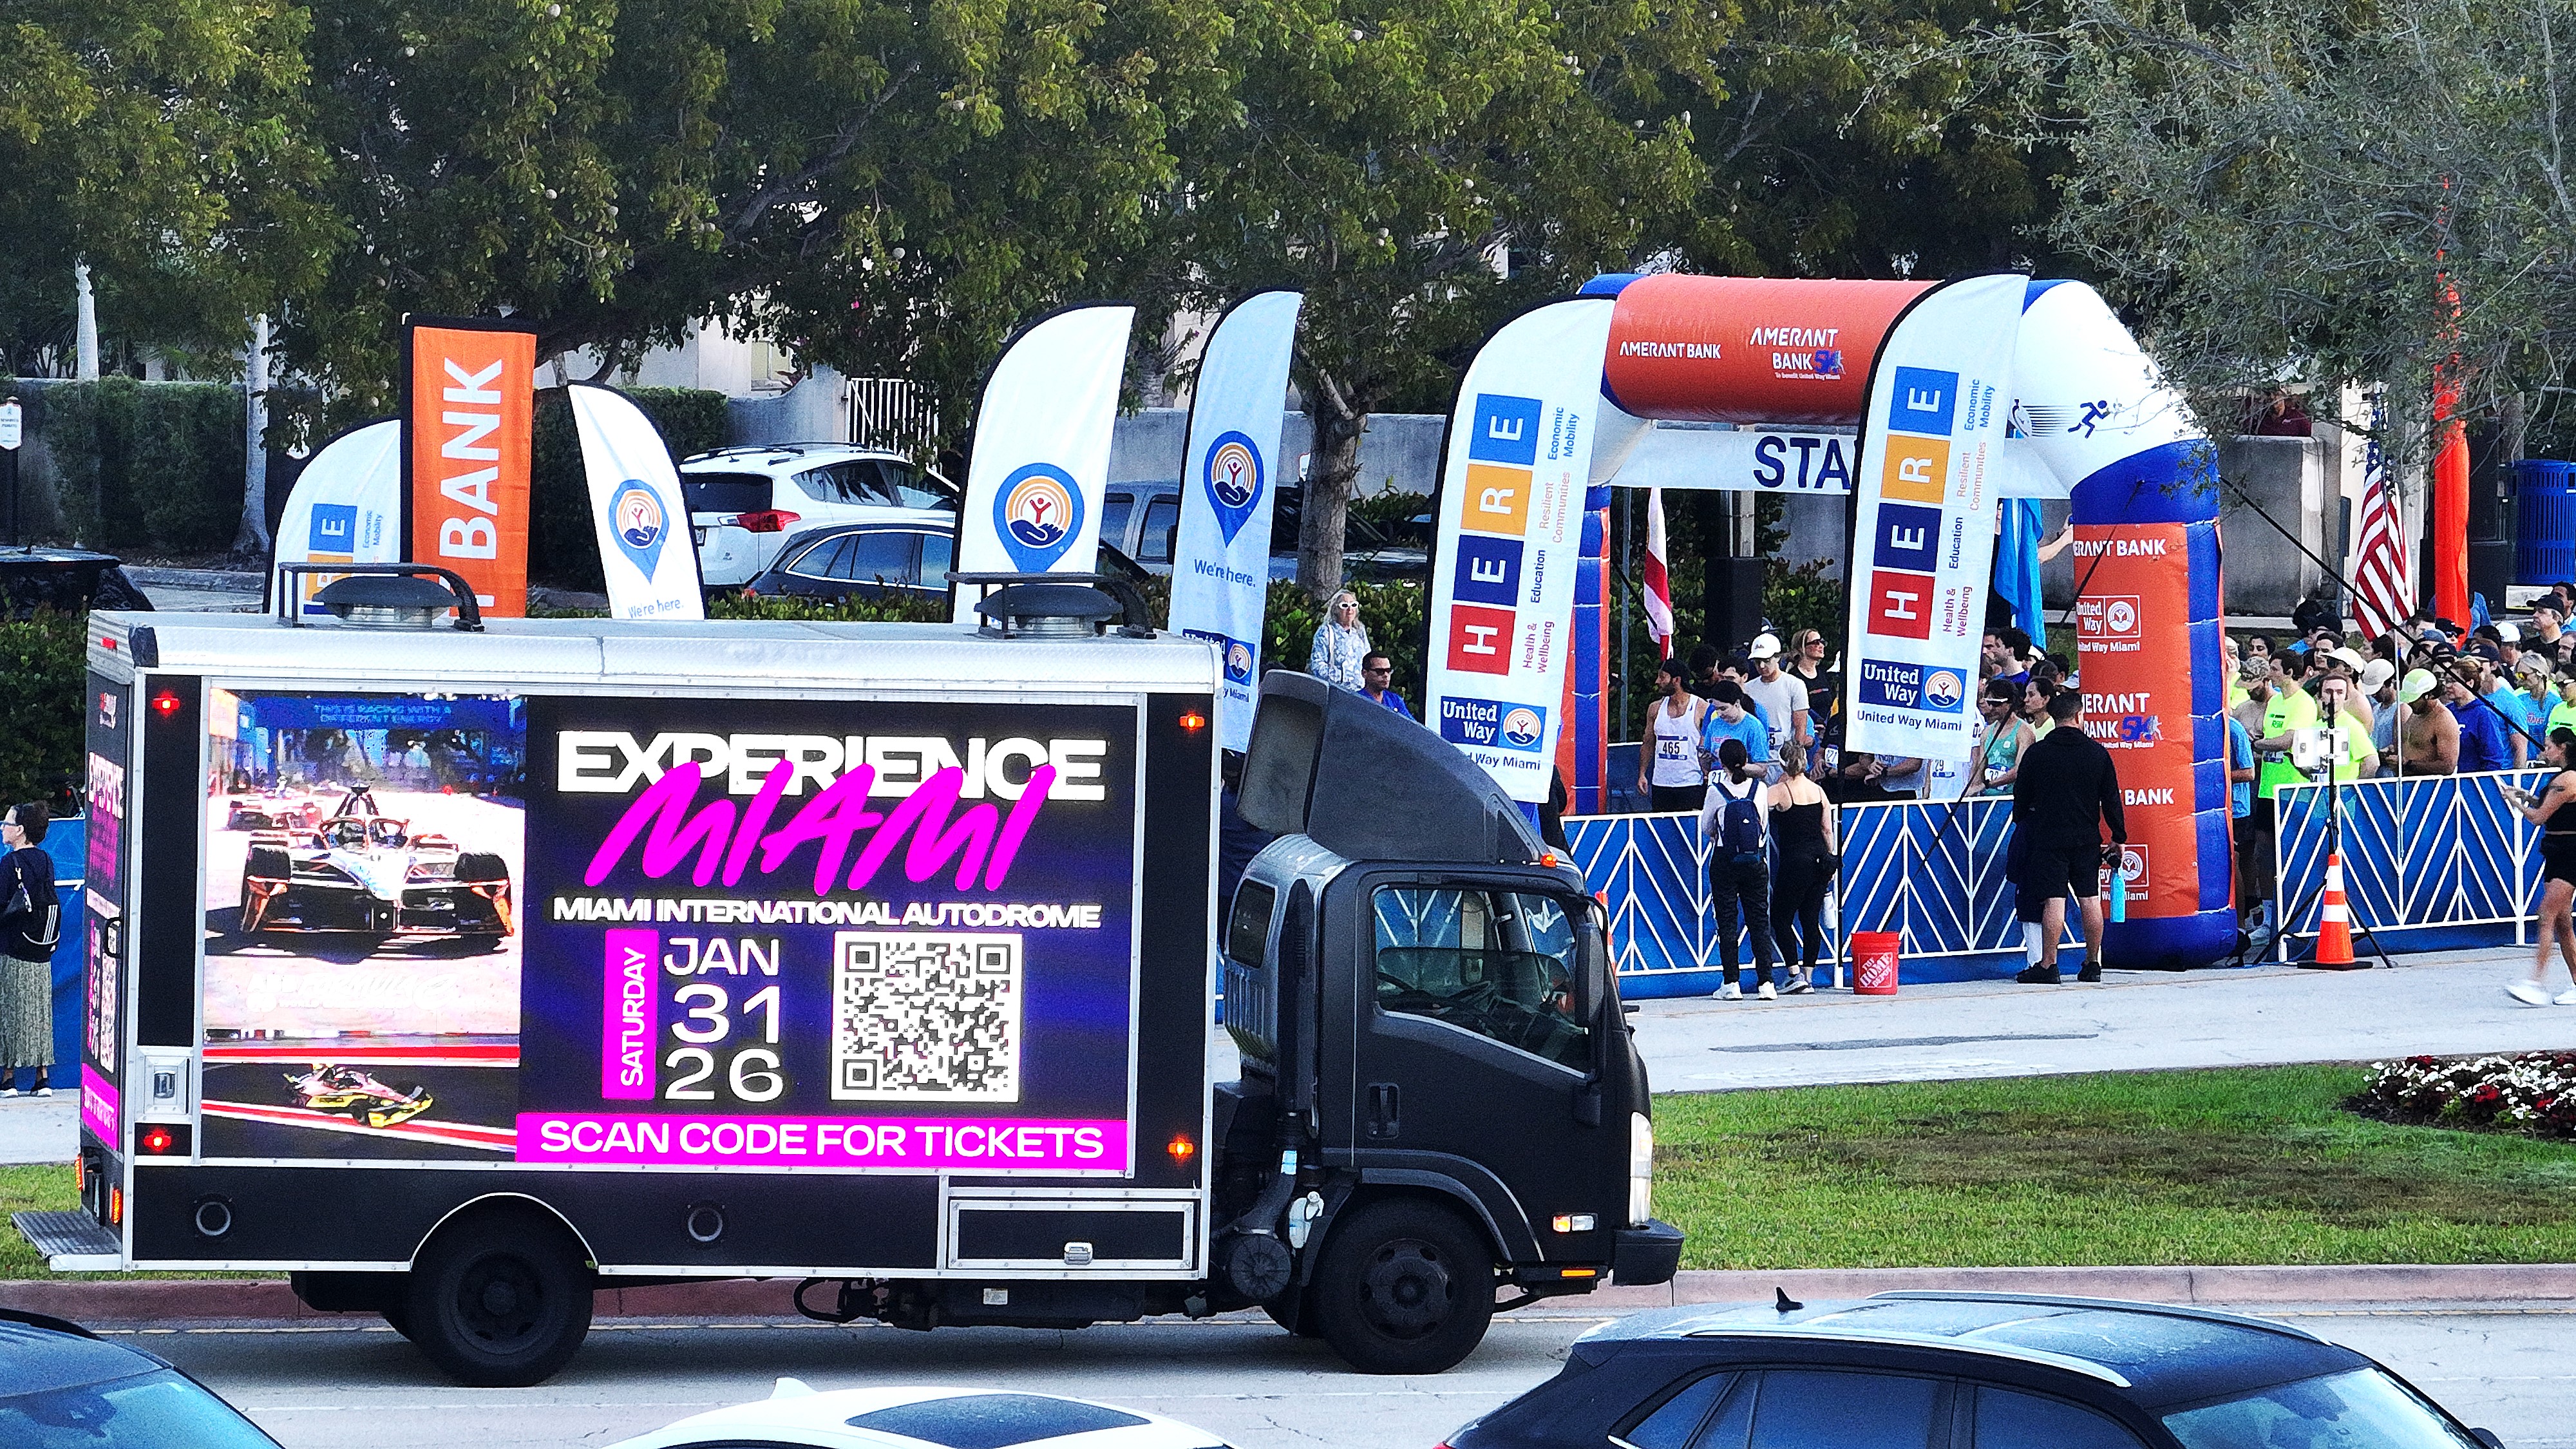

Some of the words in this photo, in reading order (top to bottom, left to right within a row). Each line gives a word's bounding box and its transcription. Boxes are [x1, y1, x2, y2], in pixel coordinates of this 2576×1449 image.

[1620, 341, 1685, 357] AMERANT
[1687, 343, 1721, 359] BANK
[1750, 327, 1839, 347] AMERANT
[1772, 352, 1813, 370] BANK
[1964, 379, 1980, 431] Economic
[1980, 385, 1995, 428] Mobility
[1548, 406, 1564, 460] Economic
[1563, 413, 1580, 457] Mobility
[439, 357, 502, 559] BANK
[1754, 435, 1852, 490] STA
[1957, 451, 1971, 498] Resilient
[1969, 442, 1986, 511] Communities
[1539, 482, 1554, 529] Resilient
[1552, 471, 1571, 544] Communities
[363, 509, 373, 548] Economic
[1949, 516, 1964, 569] Education
[2072, 540, 2114, 556] ERANT
[2116, 538, 2167, 556] BANK
[1194, 558, 1224, 579] We're
[1226, 567, 1256, 587] here.
[1530, 549, 1546, 603] Education
[656, 599, 684, 612] here.
[1942, 598, 1955, 632] Health
[1956, 586, 1973, 637] Wellbeing
[1528, 623, 1537, 631] &
[2083, 617, 2103, 634] Way
[1522, 633, 1536, 668] Health
[1537, 621, 1555, 673] Wellbeing
[2110, 641, 2140, 652] Miami
[1864, 663, 1919, 685] United
[1230, 687, 1249, 703] Miami
[1443, 701, 1497, 723] United
[1884, 683, 1918, 706] Way
[2081, 692, 2151, 714] ERANT
[1463, 721, 1496, 744] Way
[1857, 710, 1895, 724] United
[1898, 714, 1922, 730] Way
[1925, 717, 1962, 732] Miami
[557, 730, 1106, 802] EXPERIENCE
[1475, 752, 1499, 768] Way
[1503, 756, 1541, 770] Miami
[1663, 742, 1680, 755] 465
[2125, 788, 2174, 806] BANK
[584, 759, 1057, 896] MIAMI
[2099, 868, 2112, 883] ay
[554, 897, 652, 922] MIAMI
[656, 898, 900, 926] INTERNATIONAL
[902, 902, 1103, 929] AUTODROME
[663, 937, 779, 977] JAN
[620, 947, 647, 1088] SATURDAY
[672, 983, 781, 1045] 31
[665, 1048, 784, 1101] 26
[540, 1121, 670, 1154] SCAN
[679, 1122, 804, 1157] CODE
[817, 1126, 907, 1158] FOR
[912, 1126, 1104, 1159] TICKETS
